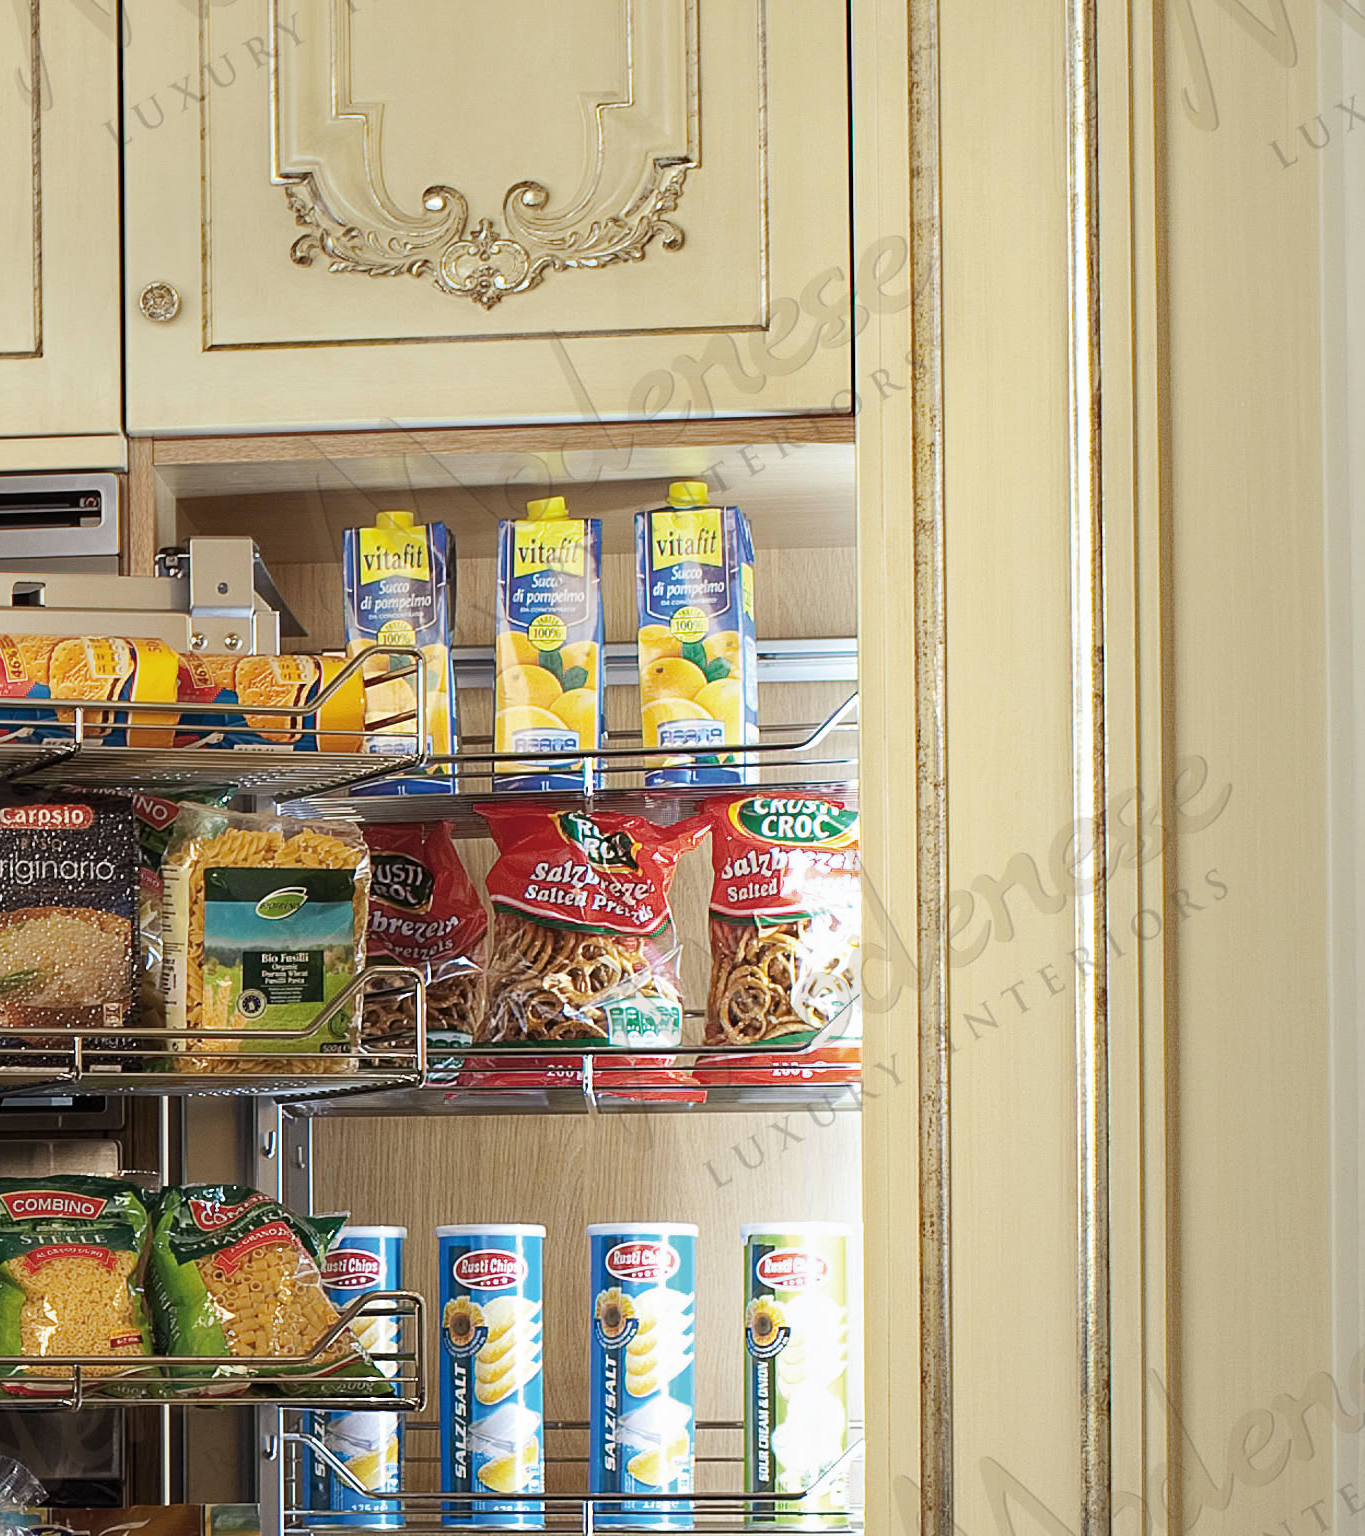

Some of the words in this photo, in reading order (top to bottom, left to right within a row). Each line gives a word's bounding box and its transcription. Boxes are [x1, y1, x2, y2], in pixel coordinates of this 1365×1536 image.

[657, 527, 717, 556] vitafit
[363, 543, 423, 571] vitafit
[518, 537, 579, 564] vitafit
[532, 573, 563, 588] Succo
[671, 566, 703, 580] Succo
[379, 581, 409, 594] Succo
[653, 582, 664, 596] di
[666, 581, 725, 599] pompelmo
[361, 596, 373, 610] di
[374, 594, 432, 611] pompelmo
[513, 589, 525, 603] di
[526, 589, 585, 606] pompelmo
[532, 627, 561, 639] 100%
[674, 619, 702, 631] 100%
[382, 633, 411, 645] 100%
[761, 815, 831, 839] CROC
[525, 884, 587, 907] Salted
[727, 882, 778, 903] Salted
[261, 953, 278, 963] Bio
[280, 952, 309, 963] Fusilli
[12, 1197, 95, 1215] COMBINO
[348, 1258, 379, 1274] Chips
[461, 1260, 488, 1274] Rusti
[453, 1363, 468, 1480] SALZ/SALT
[603, 1354, 618, 1472] SALZ/SALT
